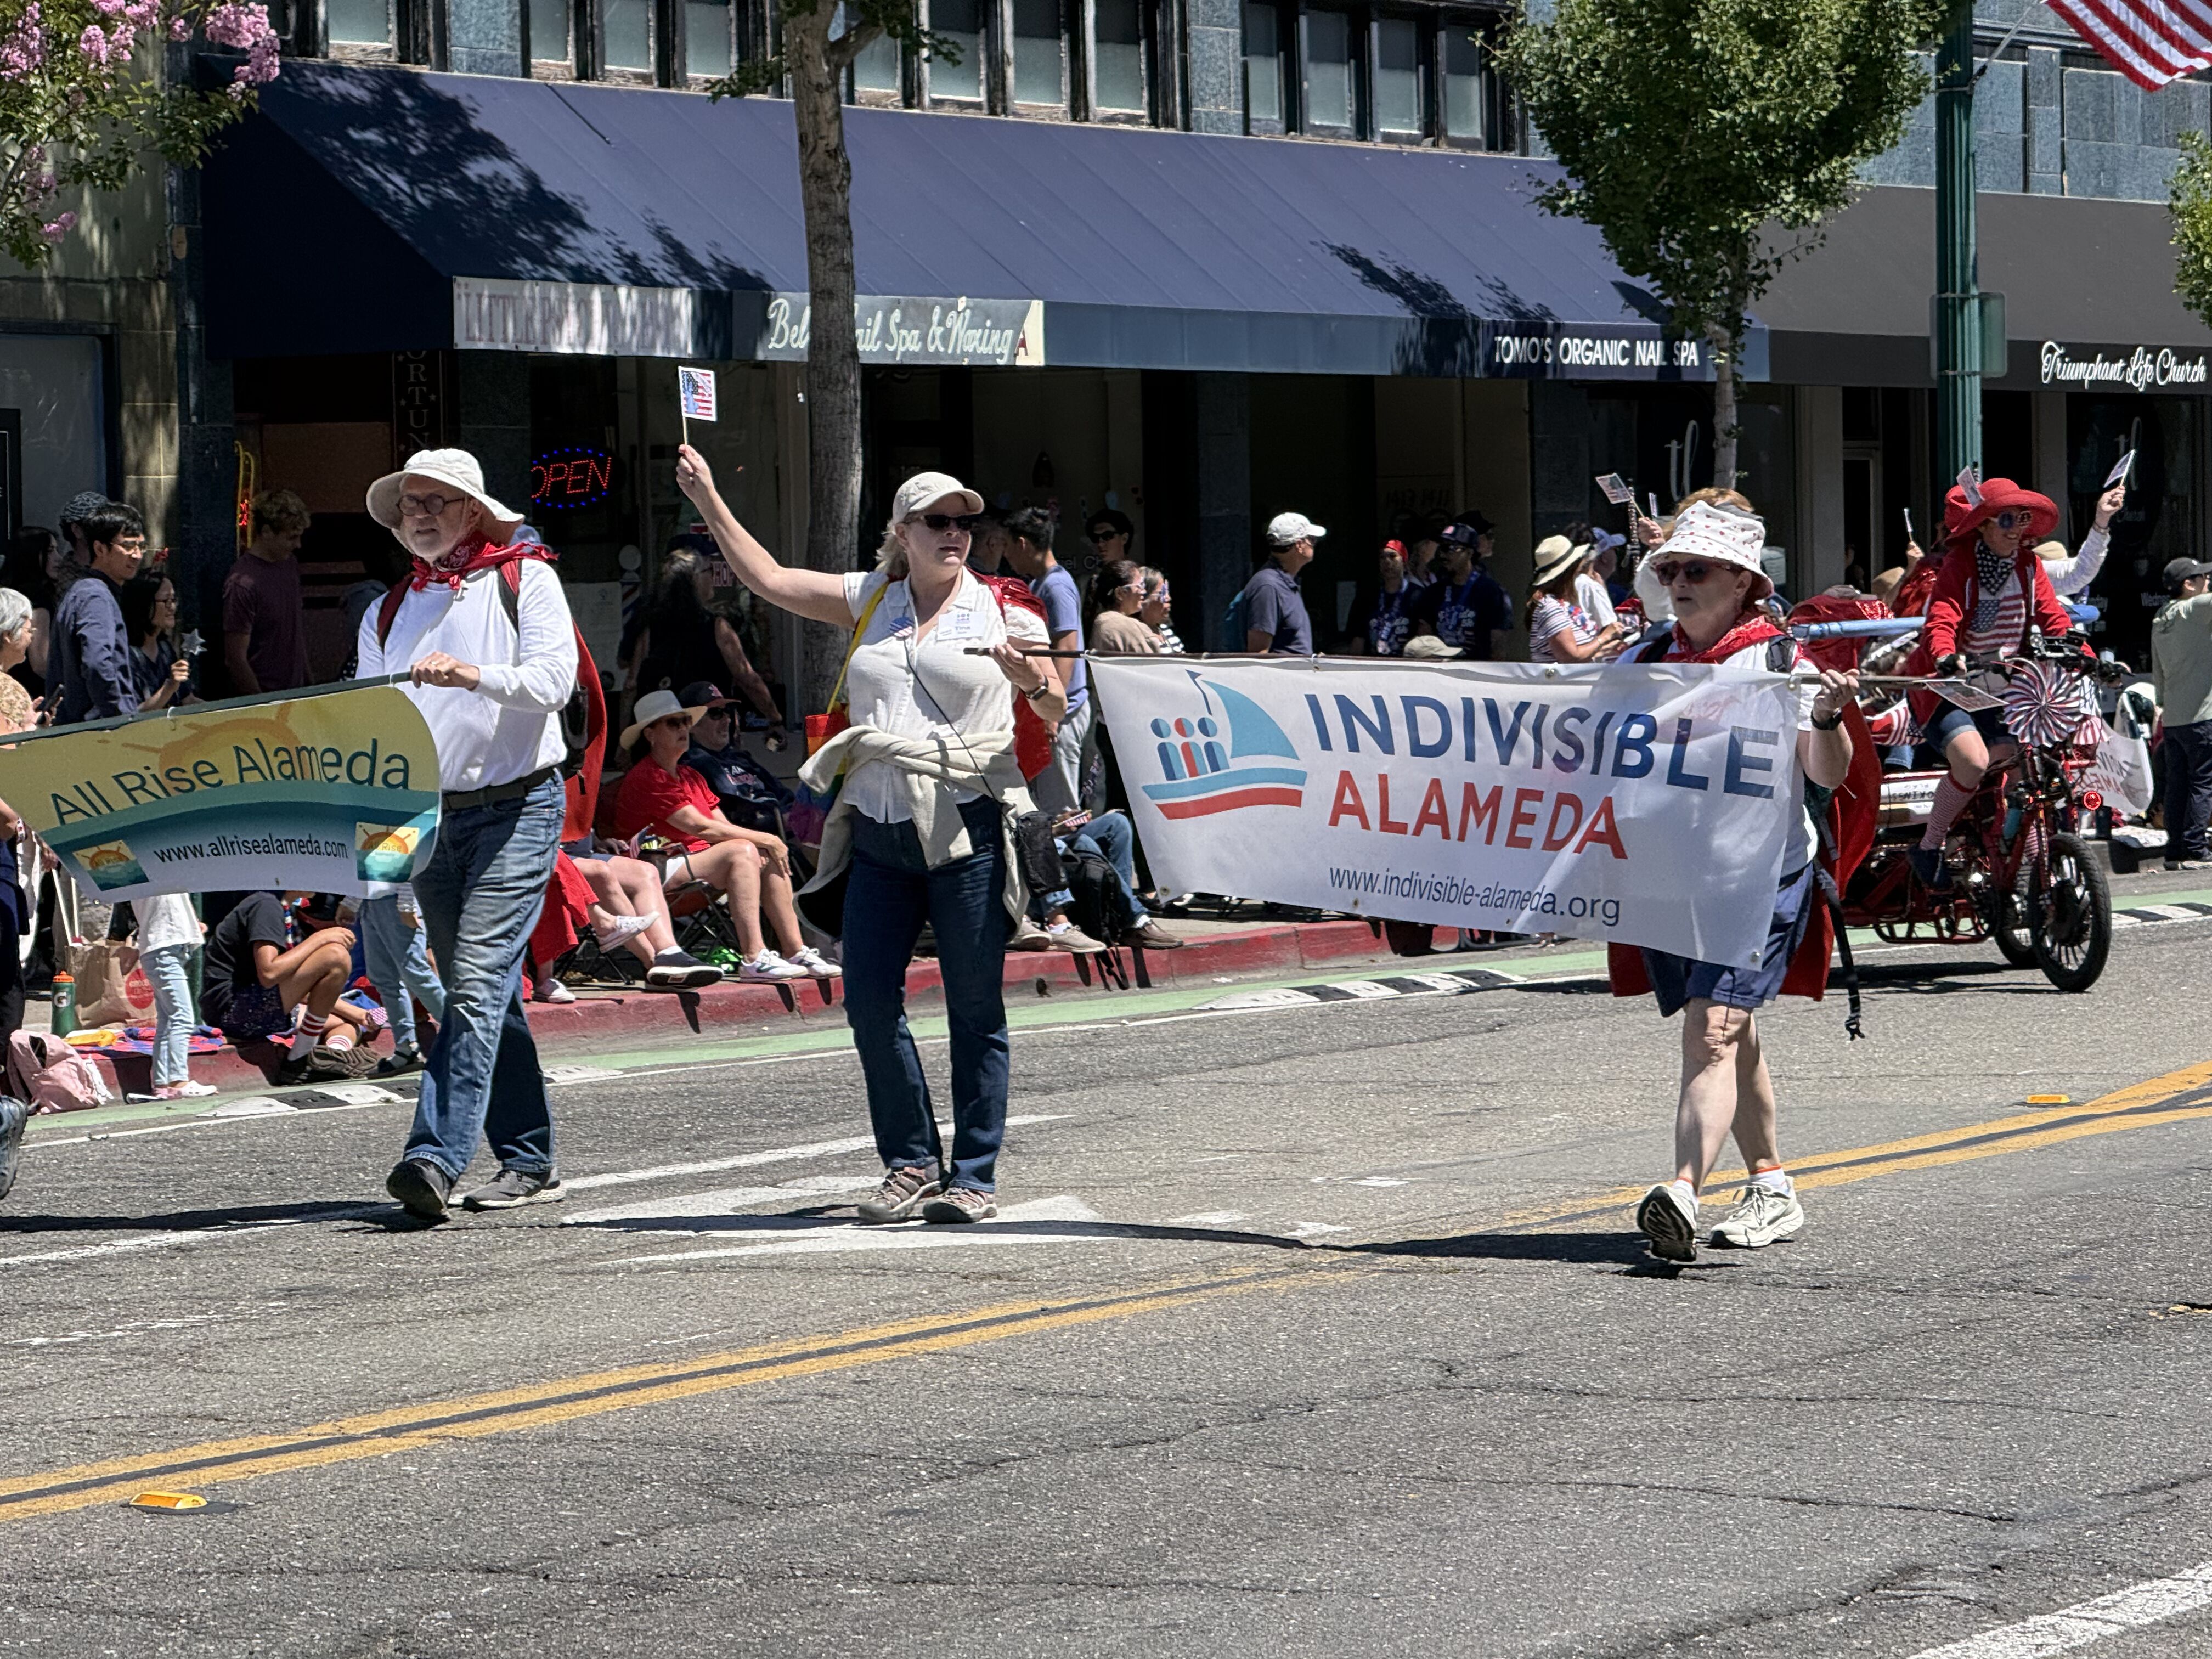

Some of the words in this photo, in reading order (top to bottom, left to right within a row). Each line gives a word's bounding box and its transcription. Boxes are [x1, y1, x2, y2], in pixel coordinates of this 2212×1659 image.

[768, 298, 810, 350] Bel
[854, 303, 881, 352] ail
[886, 309, 921, 360] Spa
[927, 306, 944, 352] &
[946, 307, 1014, 364] Waxing
[1494, 336, 1551, 364] TOMO'S
[1559, 338, 1630, 366] ORGANIC
[1635, 340, 1666, 366] NAIL
[1673, 340, 1699, 366] SPA
[2041, 341, 2125, 389] Triumphant
[2126, 347, 2155, 392] Life
[2155, 348, 2207, 386] Church
[531, 456, 612, 498] OPEN
[1304, 694, 1779, 799] INDIVISIBLE
[51, 781, 114, 825] All
[112, 760, 223, 805] Rise
[233, 738, 410, 790] Alameda
[1328, 770, 1628, 860] ALAMEDA
[154, 833, 349, 864] www.allrisealameda.com
[381, 842, 402, 852] Rise
[1330, 867, 1621, 927] www.indivisible-alameda.org
[54, 992, 70, 1008] G
